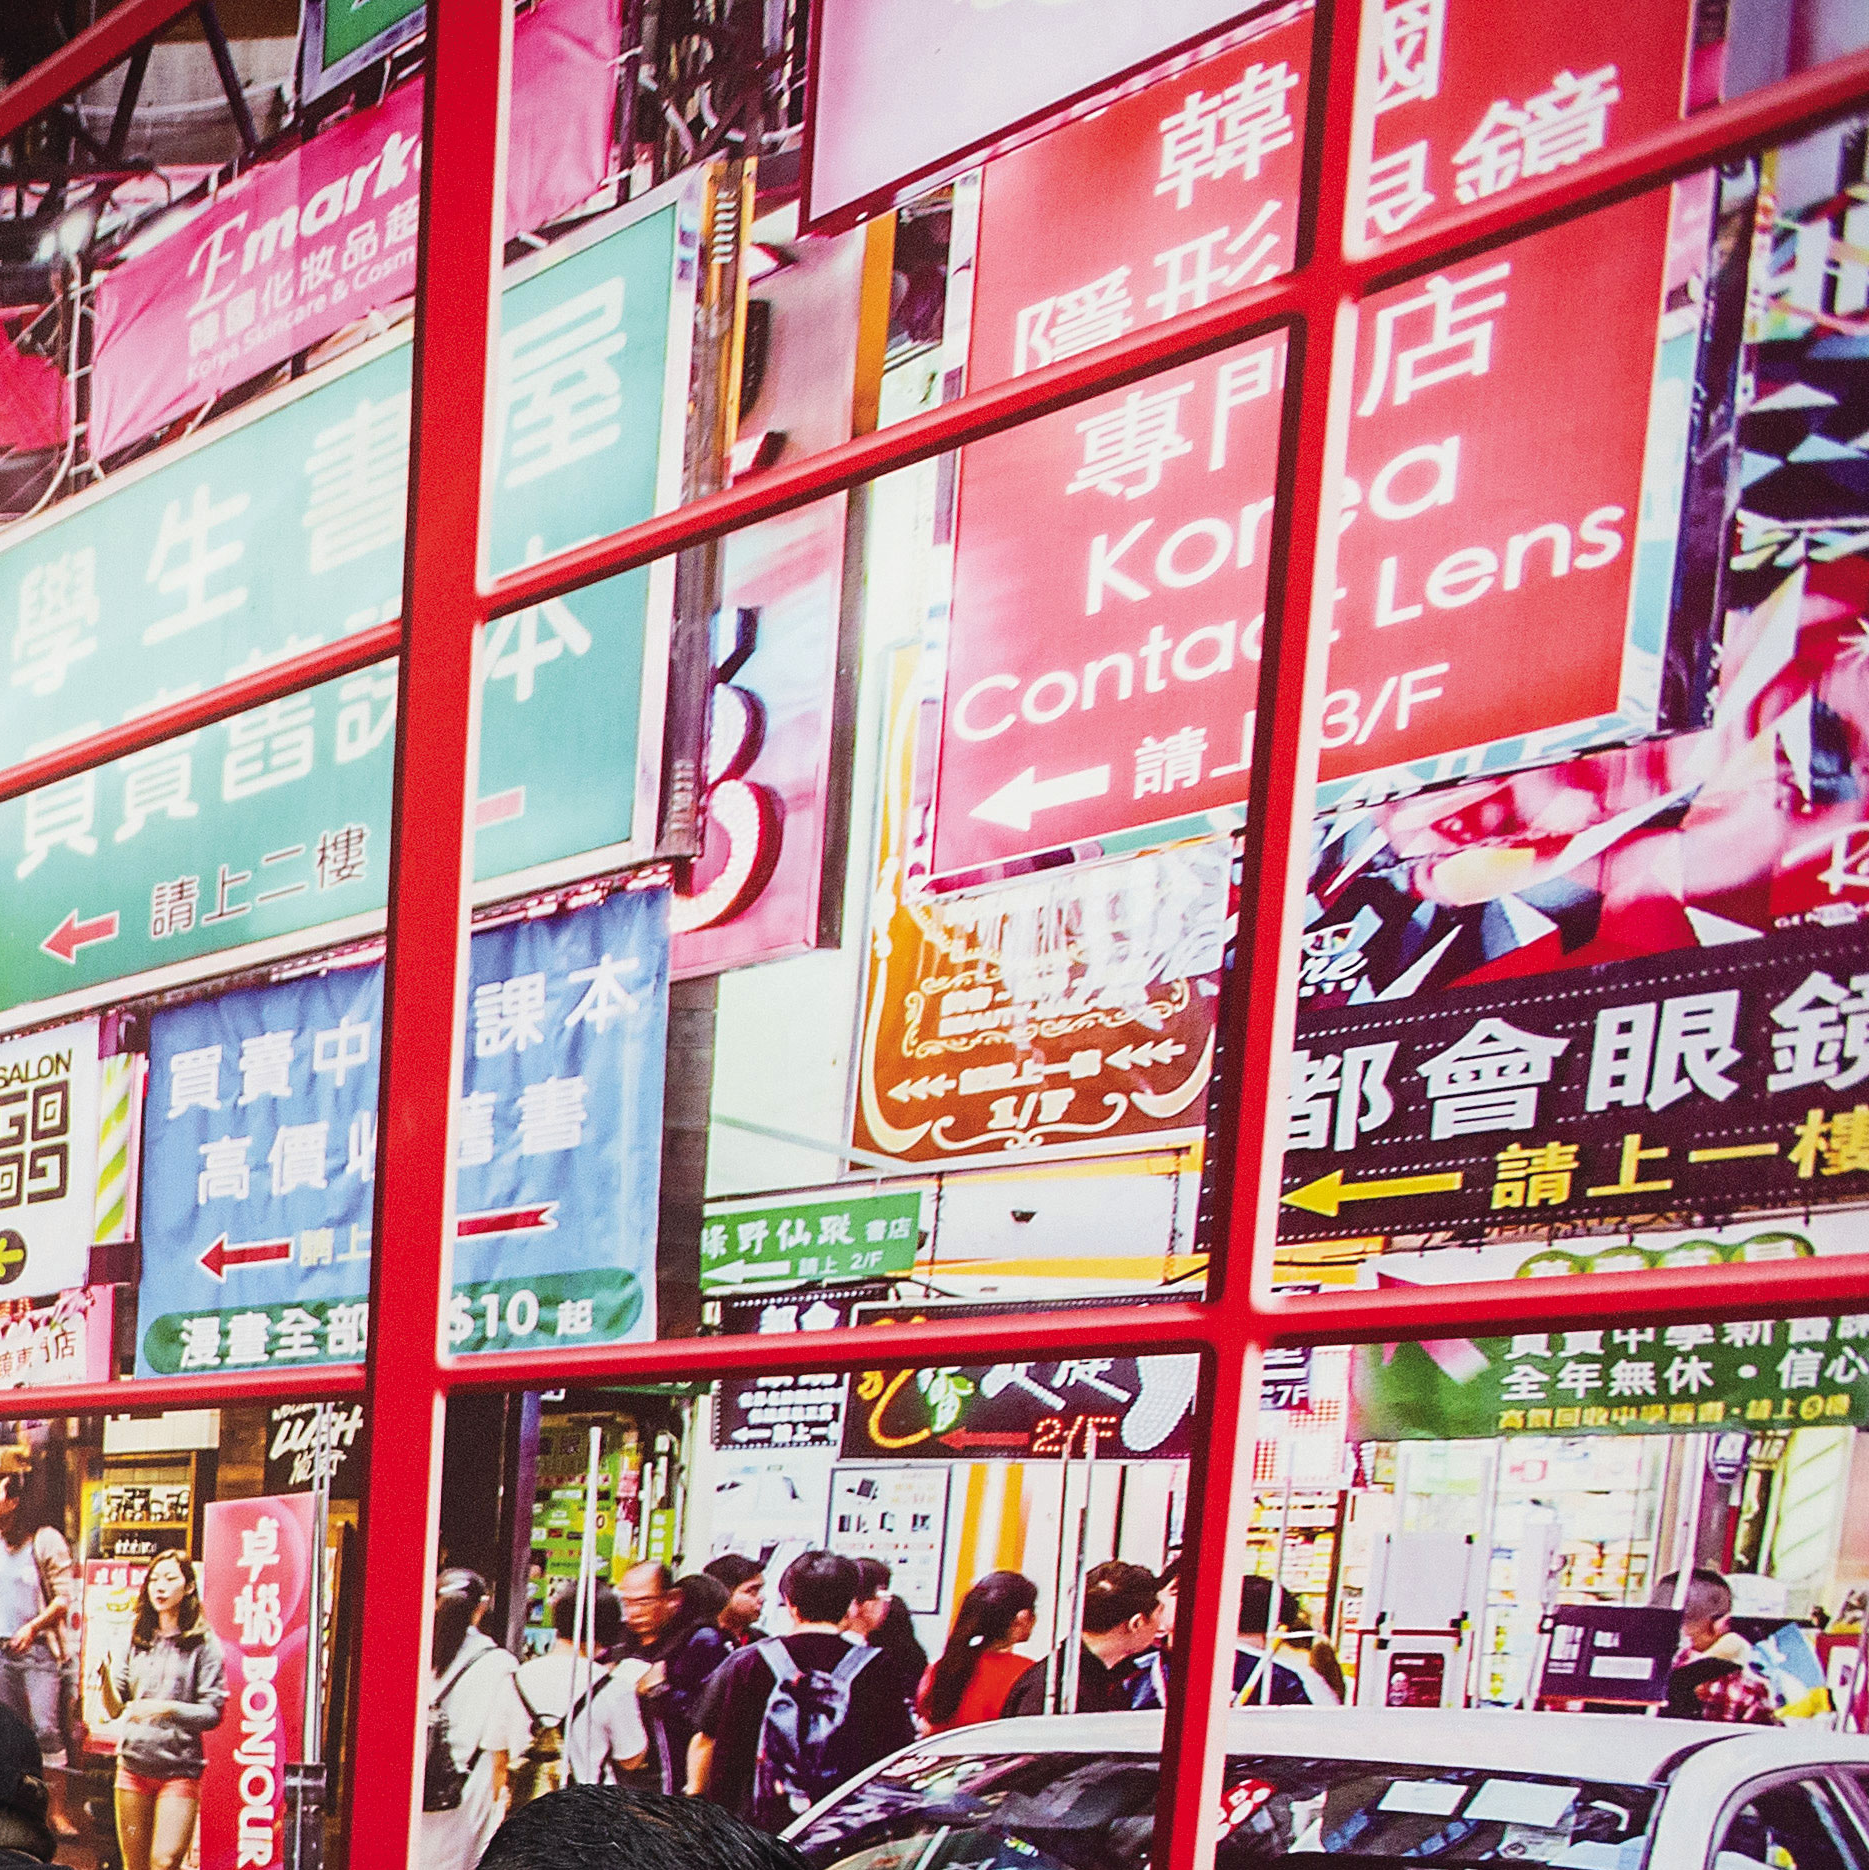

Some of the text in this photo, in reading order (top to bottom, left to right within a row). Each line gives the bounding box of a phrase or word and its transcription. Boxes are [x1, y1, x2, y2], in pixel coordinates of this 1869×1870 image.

[186, 132, 421, 318] Emark
[353, 245, 416, 290] Cosm
[1085, 436, 1460, 617] Kora
[1375, 505, 1626, 628] Lens
[150, 823, 369, 938] 請上二樓
[168, 953, 638, 1120] 買賣中課本
[448, 1288, 540, 1345] $10
[557, 1300, 594, 1337] 起
[850, 1251, 883, 1270] 2/F
[1032, 1416, 1116, 1453] 2/F
[1500, 1356, 1714, 1400] 全年無休
[237, 1656, 278, 1868] BONJOUR
